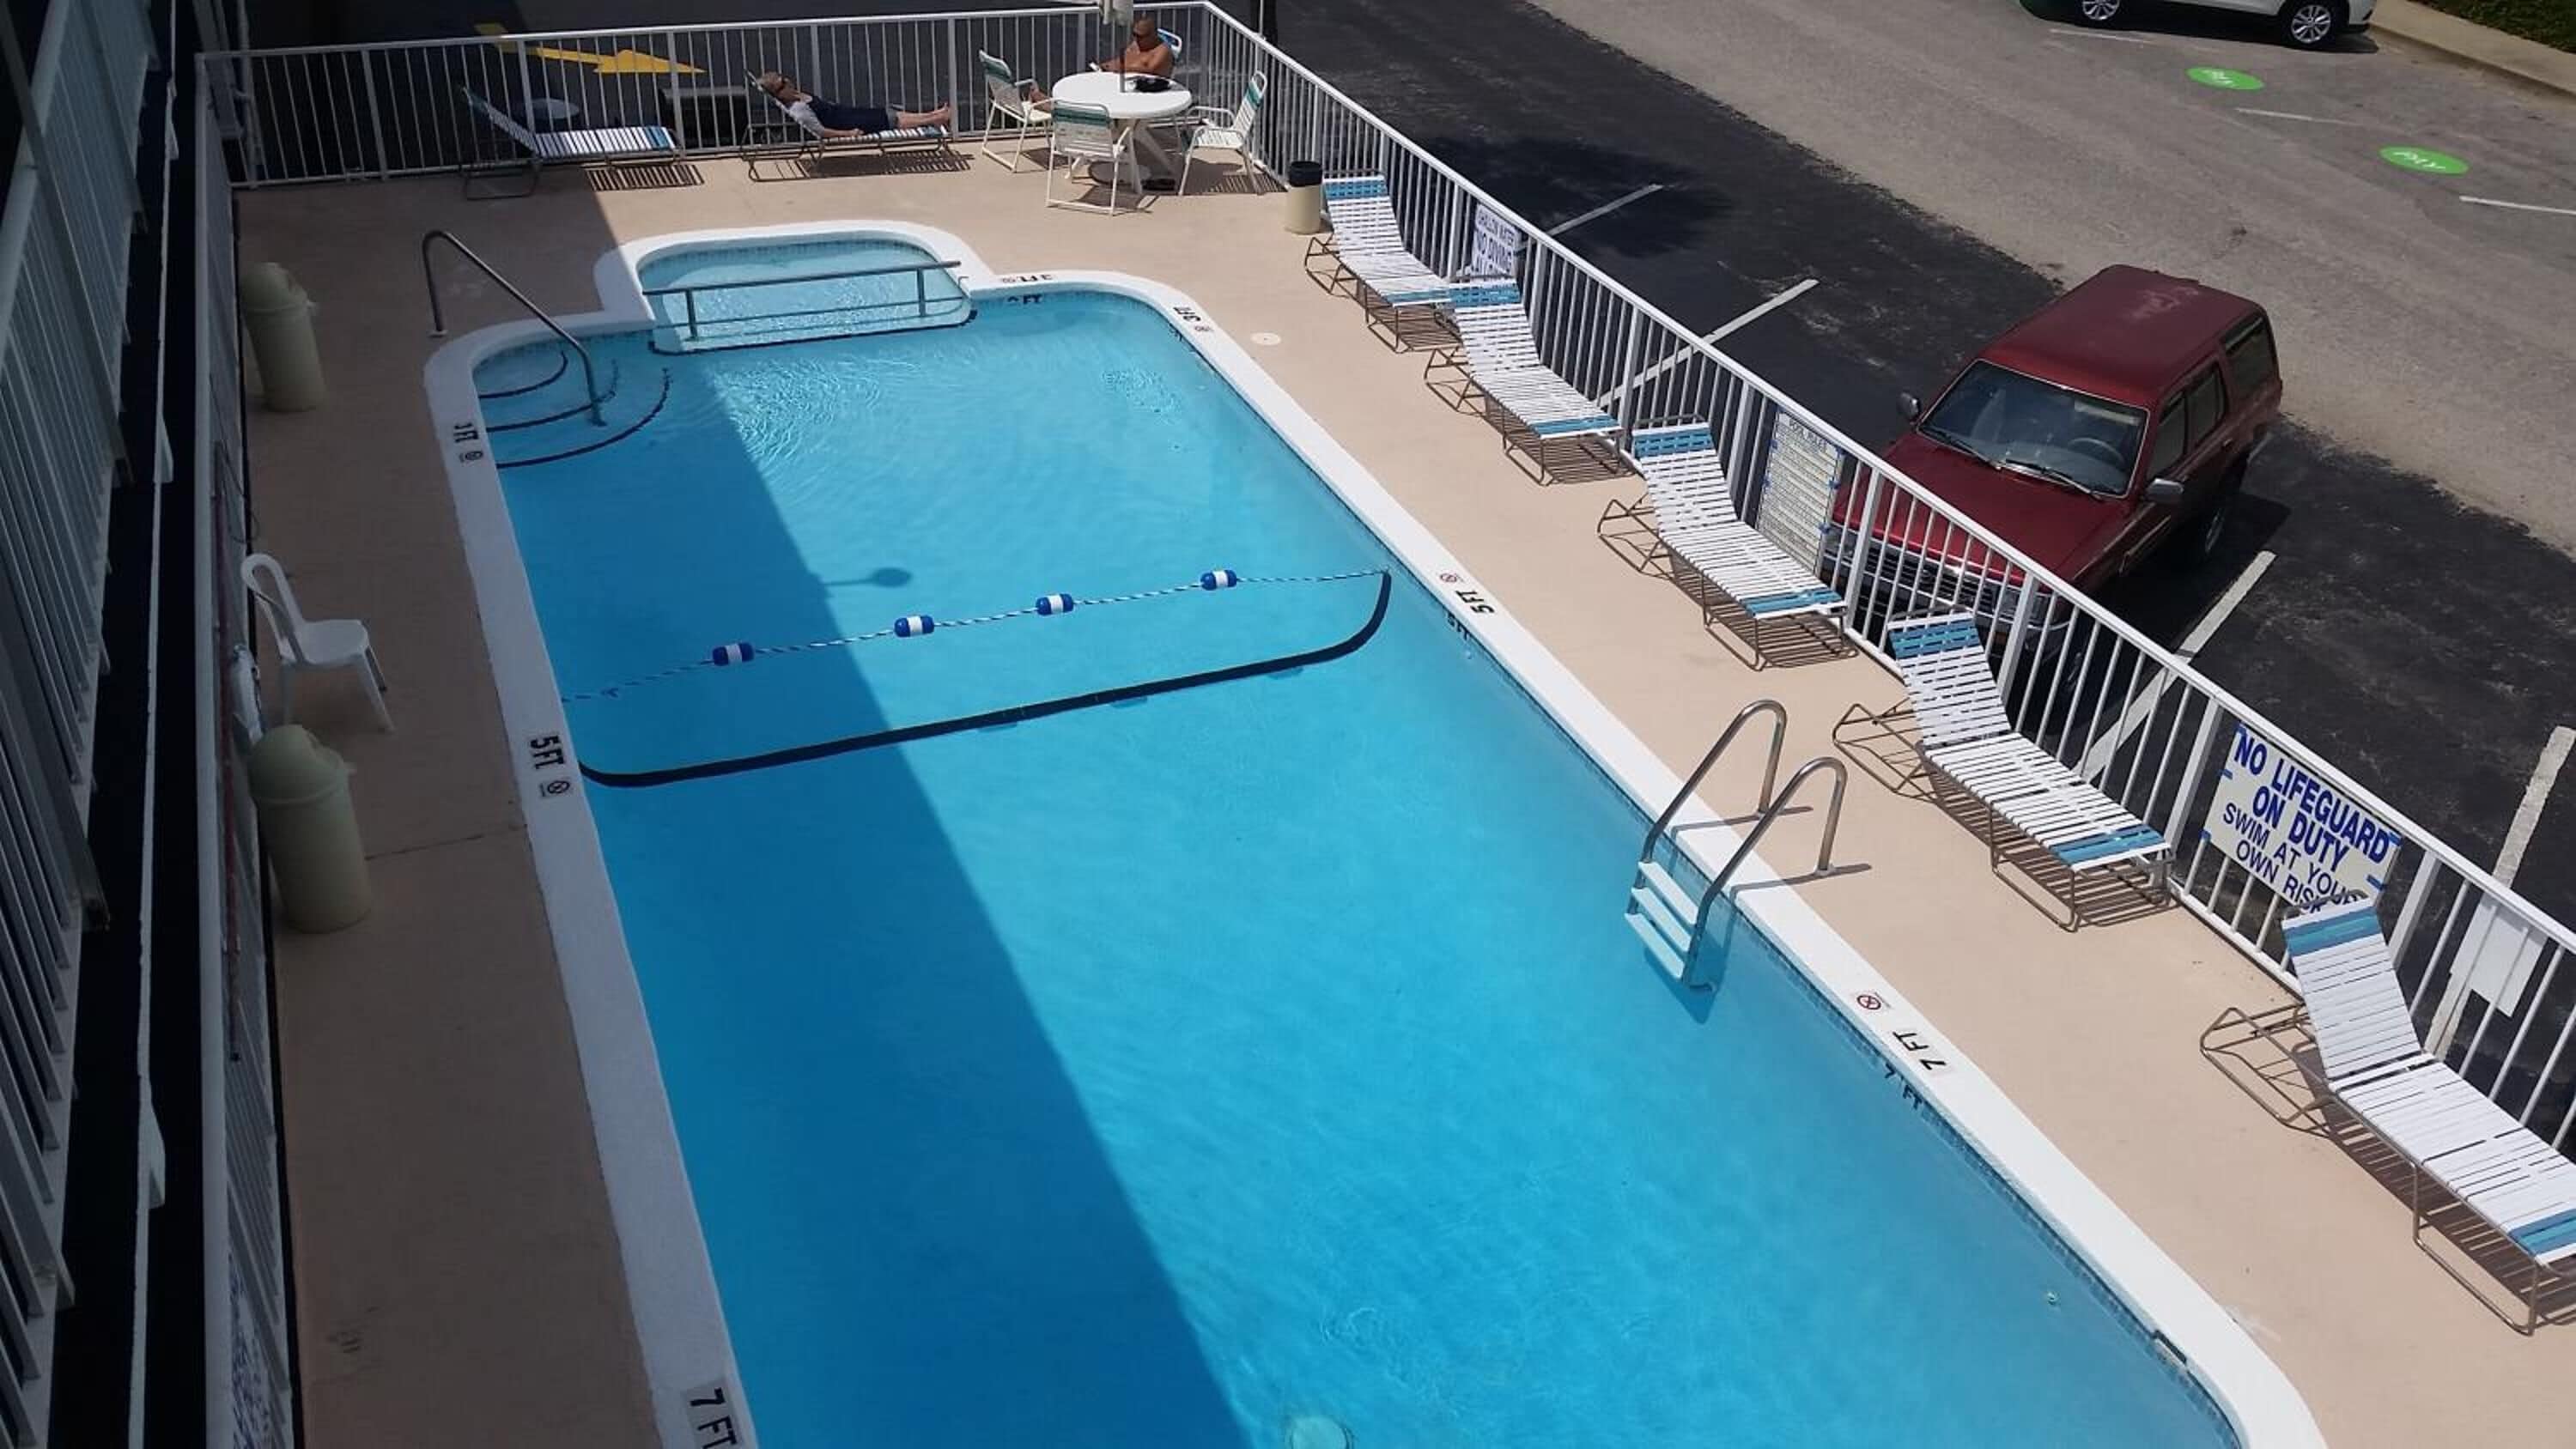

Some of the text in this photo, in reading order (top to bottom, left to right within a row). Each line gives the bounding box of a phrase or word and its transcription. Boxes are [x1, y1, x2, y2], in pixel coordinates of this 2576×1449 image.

[1476, 230, 1486, 255] NO
[1455, 590, 1495, 614] 5FT
[530, 734, 565, 771] 5FT
[2234, 735, 2391, 864] NO LIFEGUARD
[2222, 803, 2270, 850] SWIM
[2274, 842, 2301, 870] AT
[2252, 785, 2350, 873] ON DUTY
[2236, 840, 2279, 884] OWN
[1892, 1031, 1947, 1071] 7 FT
[690, 1387, 738, 1449] 7 FT
